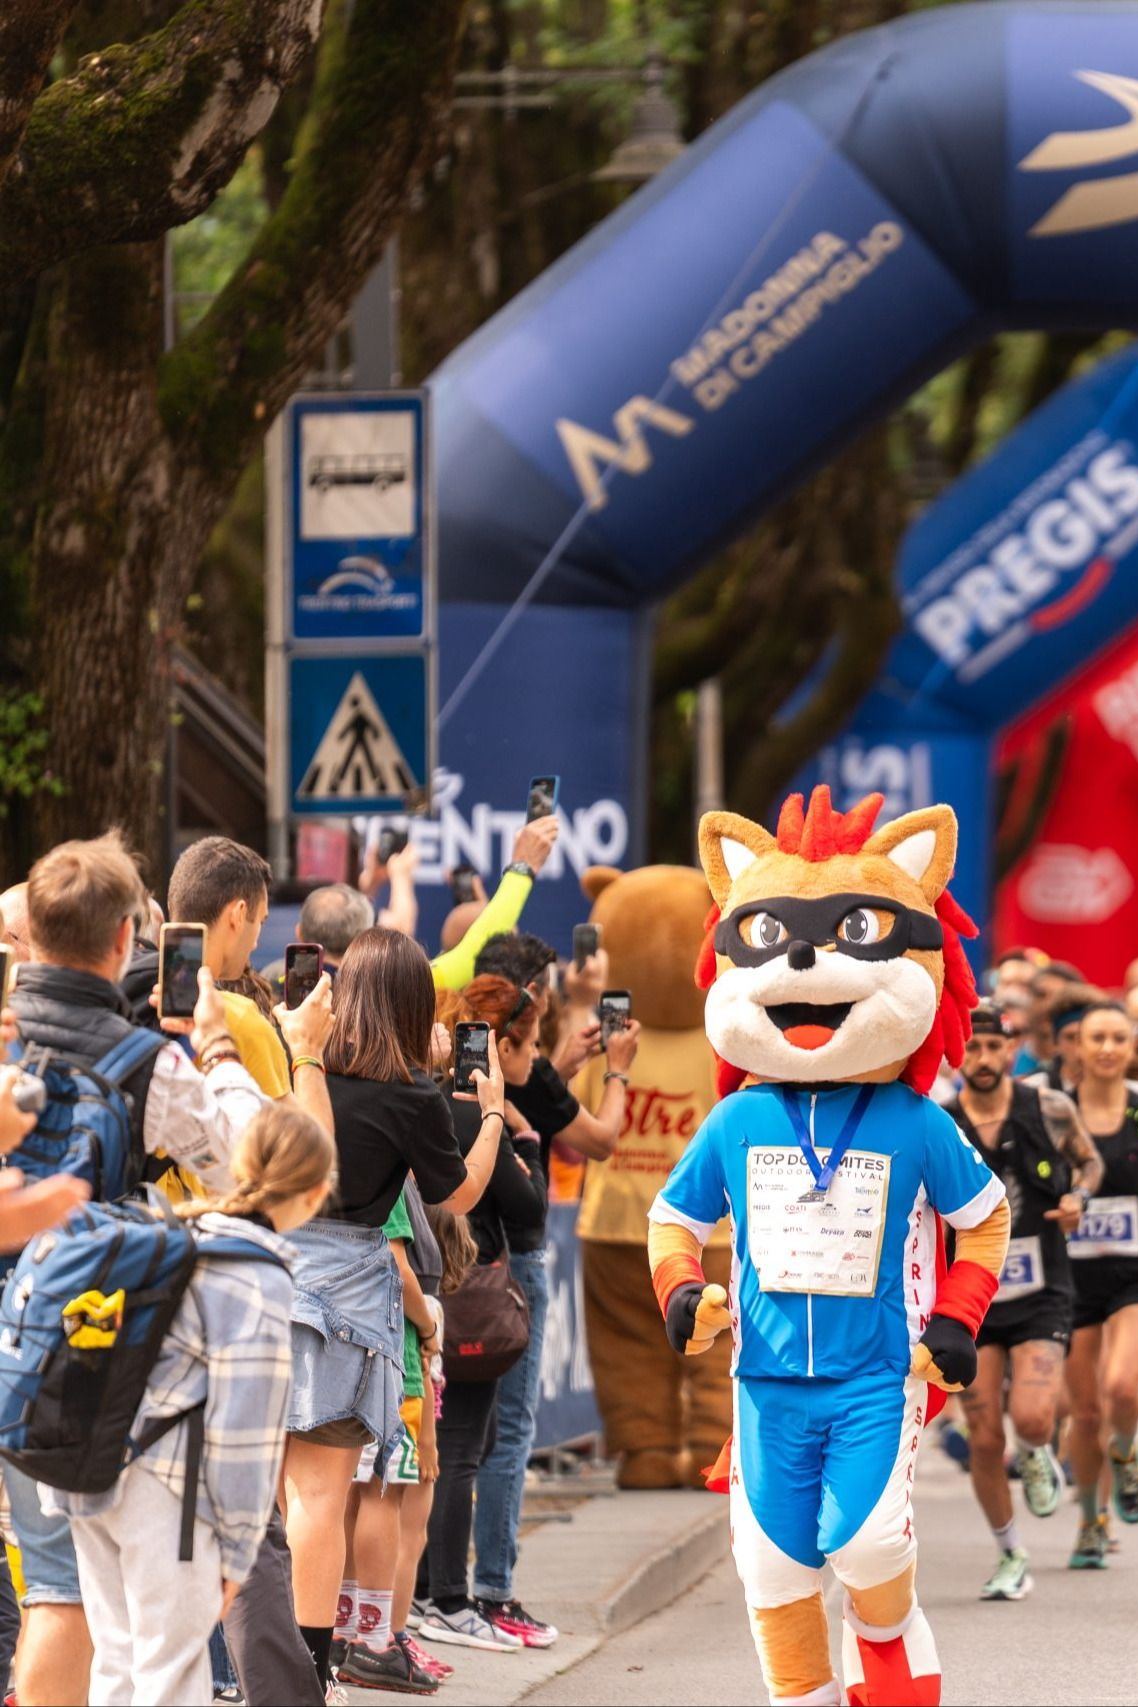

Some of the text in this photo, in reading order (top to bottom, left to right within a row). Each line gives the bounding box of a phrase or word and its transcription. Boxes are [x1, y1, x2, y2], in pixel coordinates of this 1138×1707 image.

[669, 231, 848, 387] MADONNA
[694, 221, 904, 411] DI CAMPIGLIO
[753, 1153, 885, 1171] TOP DOOMITES
